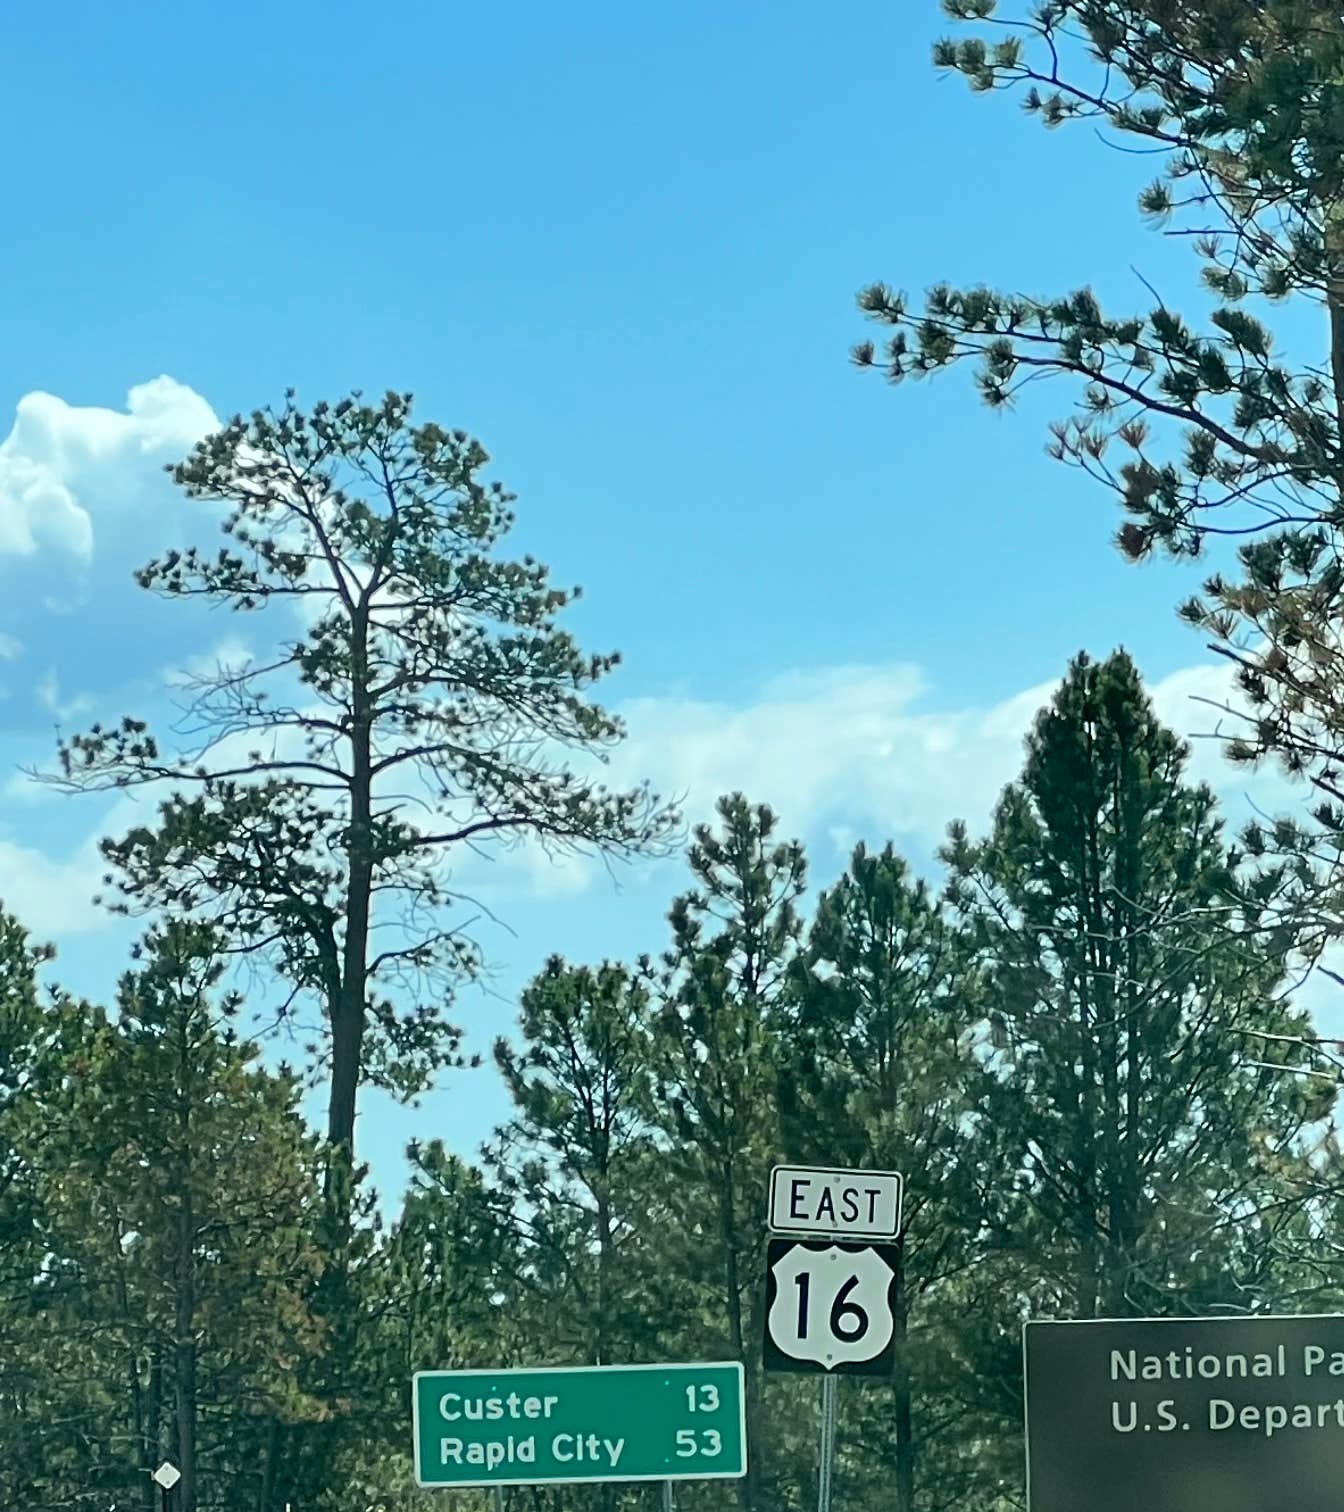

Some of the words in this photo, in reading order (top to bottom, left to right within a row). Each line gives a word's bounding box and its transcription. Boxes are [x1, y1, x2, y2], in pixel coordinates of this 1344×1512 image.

[789, 1179, 882, 1223] EAST
[794, 1271, 869, 1343] 16
[1109, 1344, 1285, 1381] National
[439, 1392, 558, 1421] Custer
[685, 1384, 721, 1413] 13
[1110, 1400, 1191, 1433] U.S.
[440, 1436, 536, 1471] Rapid
[552, 1433, 625, 1467] City
[676, 1430, 722, 1458] 53
